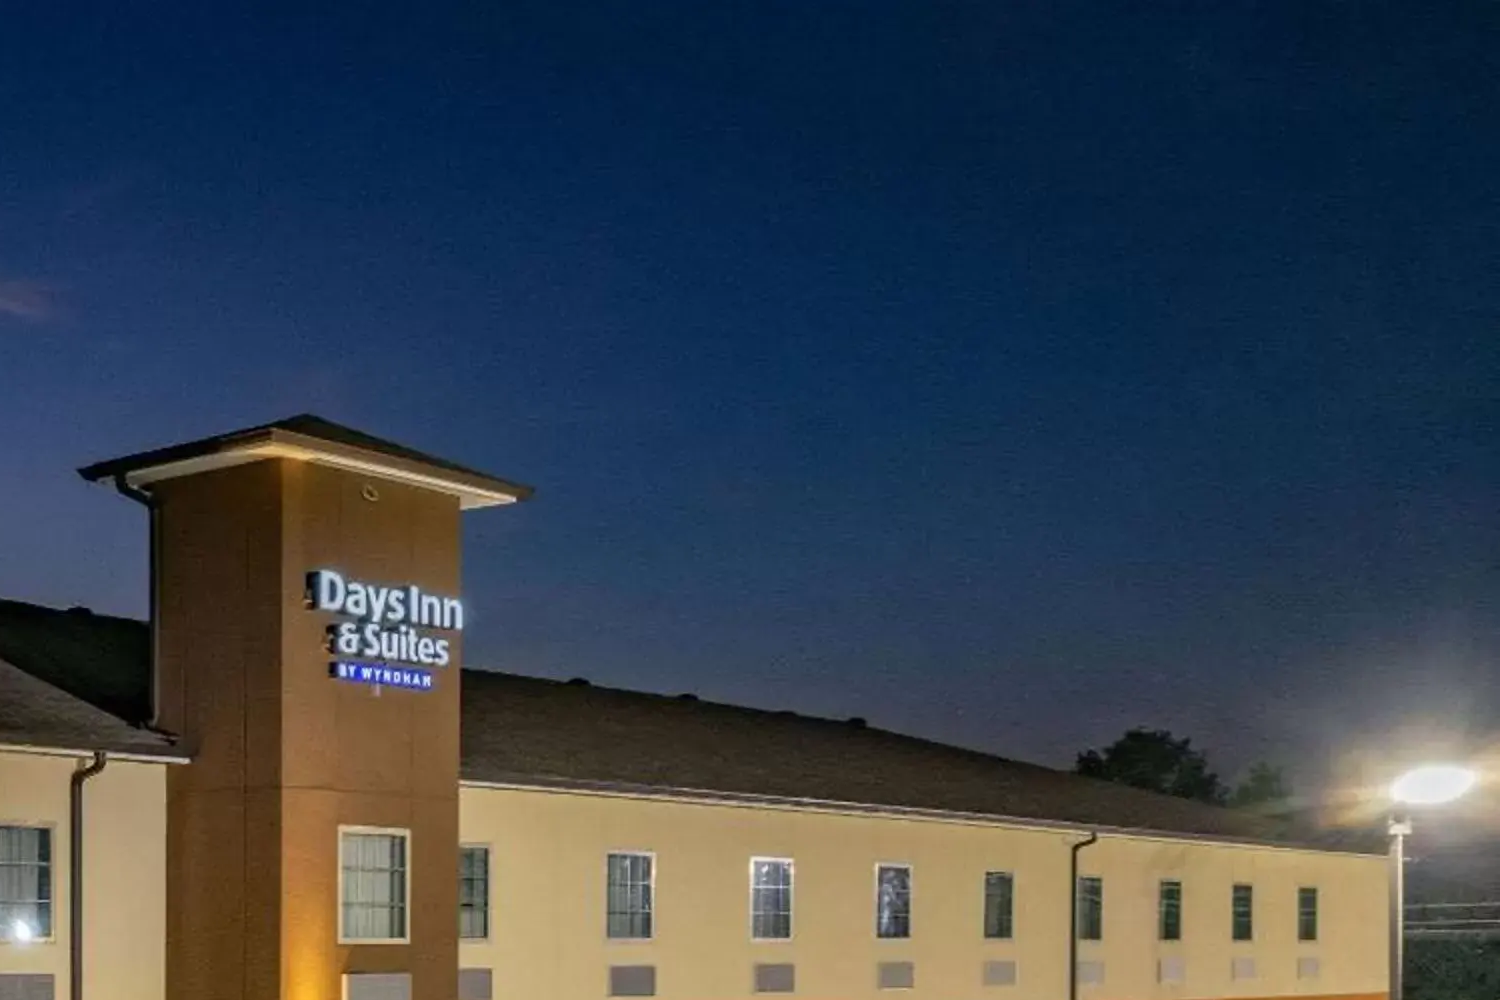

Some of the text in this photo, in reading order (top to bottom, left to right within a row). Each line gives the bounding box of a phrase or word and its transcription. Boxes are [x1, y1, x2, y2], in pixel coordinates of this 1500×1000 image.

[319, 569, 464, 630] Days Inn
[338, 622, 449, 666] & Suites
[338, 663, 431, 687] BY WYNDHAM
